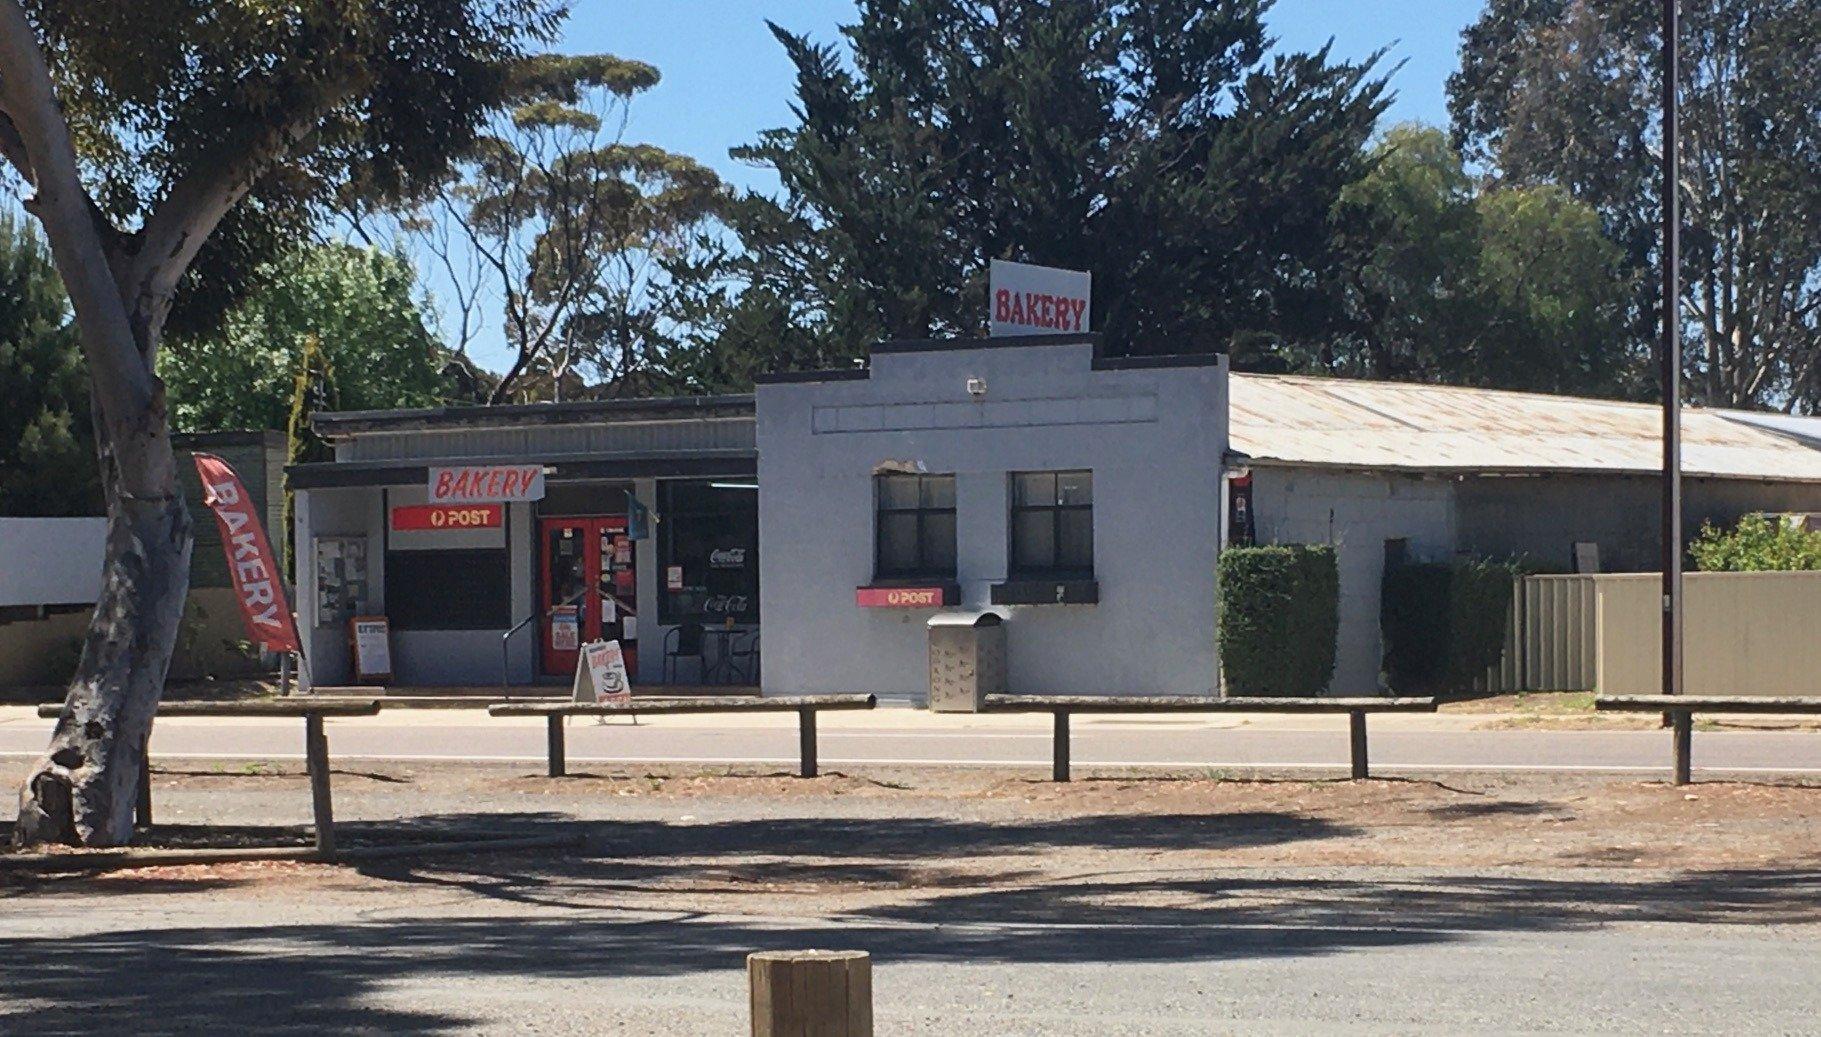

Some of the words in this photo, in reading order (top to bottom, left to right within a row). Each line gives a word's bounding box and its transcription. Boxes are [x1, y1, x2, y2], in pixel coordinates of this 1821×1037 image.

[995, 288, 1086, 331] BAKERY
[434, 468, 538, 499] BAKERY
[448, 509, 490, 526] POST
[211, 481, 283, 630] BAKERY
[900, 591, 935, 604] POST
